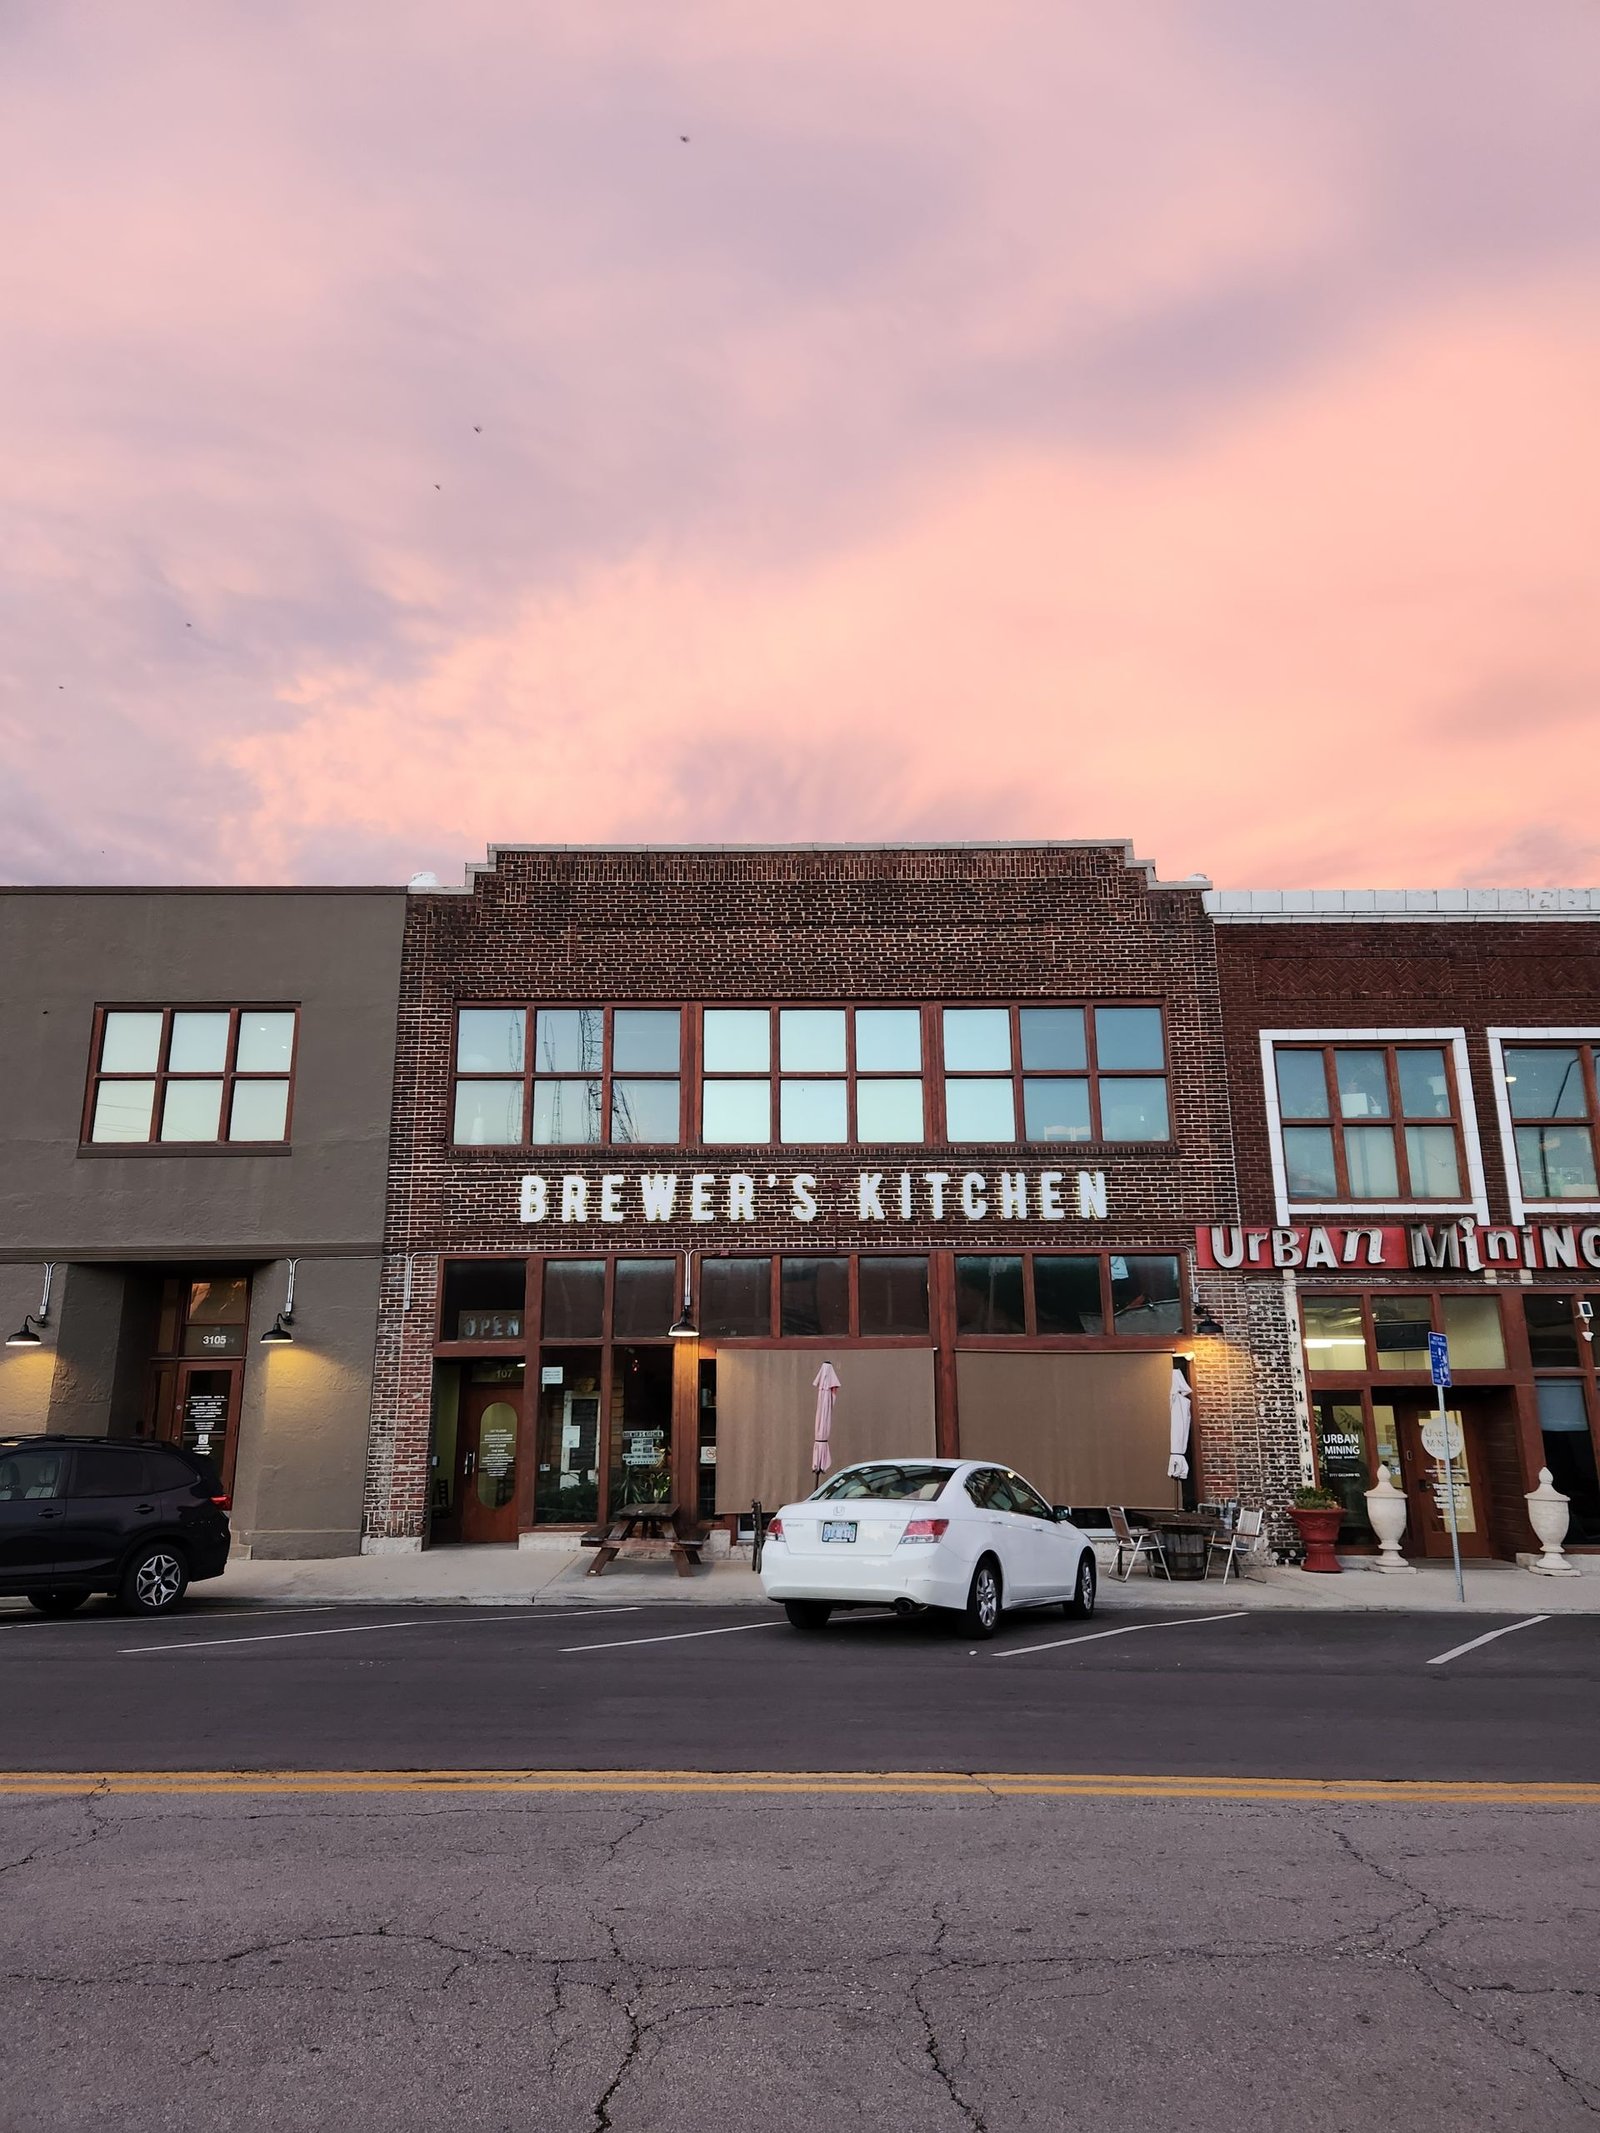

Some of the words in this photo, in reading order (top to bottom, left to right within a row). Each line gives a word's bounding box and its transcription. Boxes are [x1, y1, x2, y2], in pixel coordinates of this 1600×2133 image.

[520, 1173, 817, 1223] BREWER'S
[858, 1171, 1108, 1220] KITCHEN
[464, 1315, 520, 1337] OPEN
[202, 1335, 227, 1345] 3105
[496, 1369, 513, 1379] 107
[1322, 1433, 1359, 1444] URBAN
[1324, 1445, 1361, 1455] MINING
